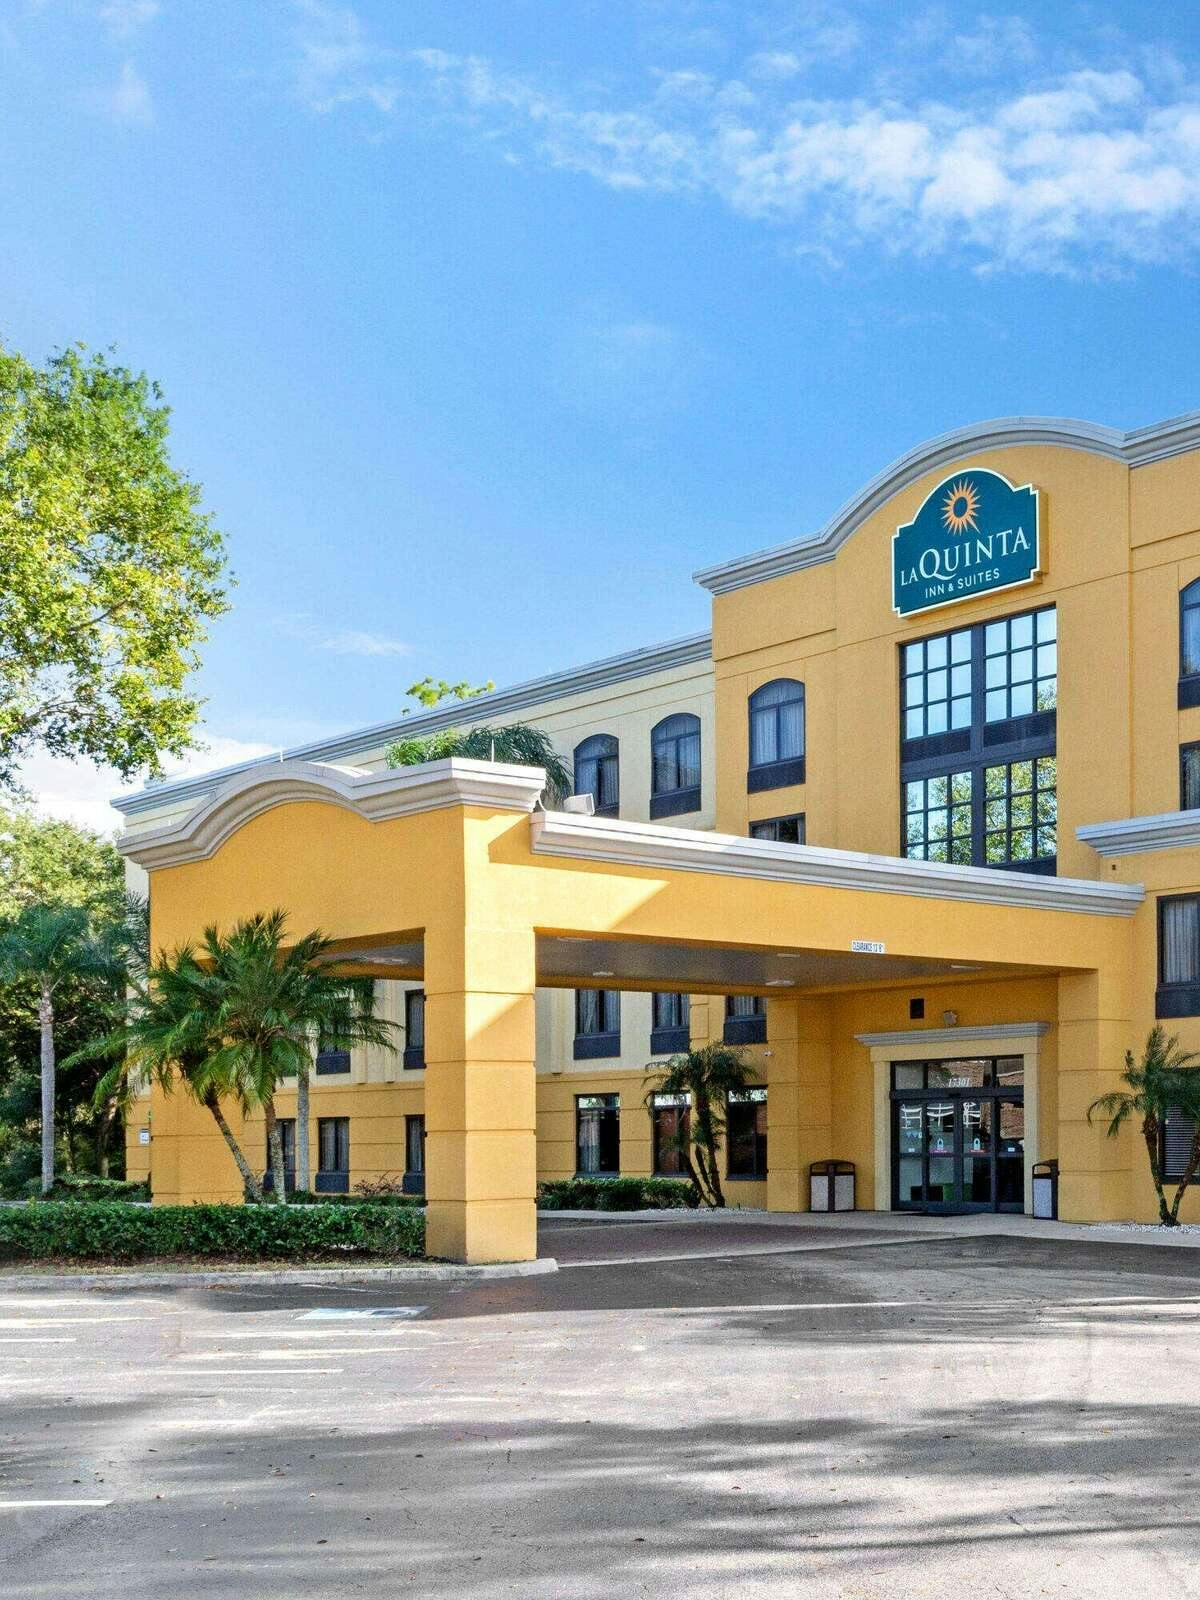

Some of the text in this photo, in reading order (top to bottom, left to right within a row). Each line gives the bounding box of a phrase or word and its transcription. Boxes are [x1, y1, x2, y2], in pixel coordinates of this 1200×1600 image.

[901, 526, 1030, 586] LA QUINTA
[925, 568, 1000, 599] INN & SUITES
